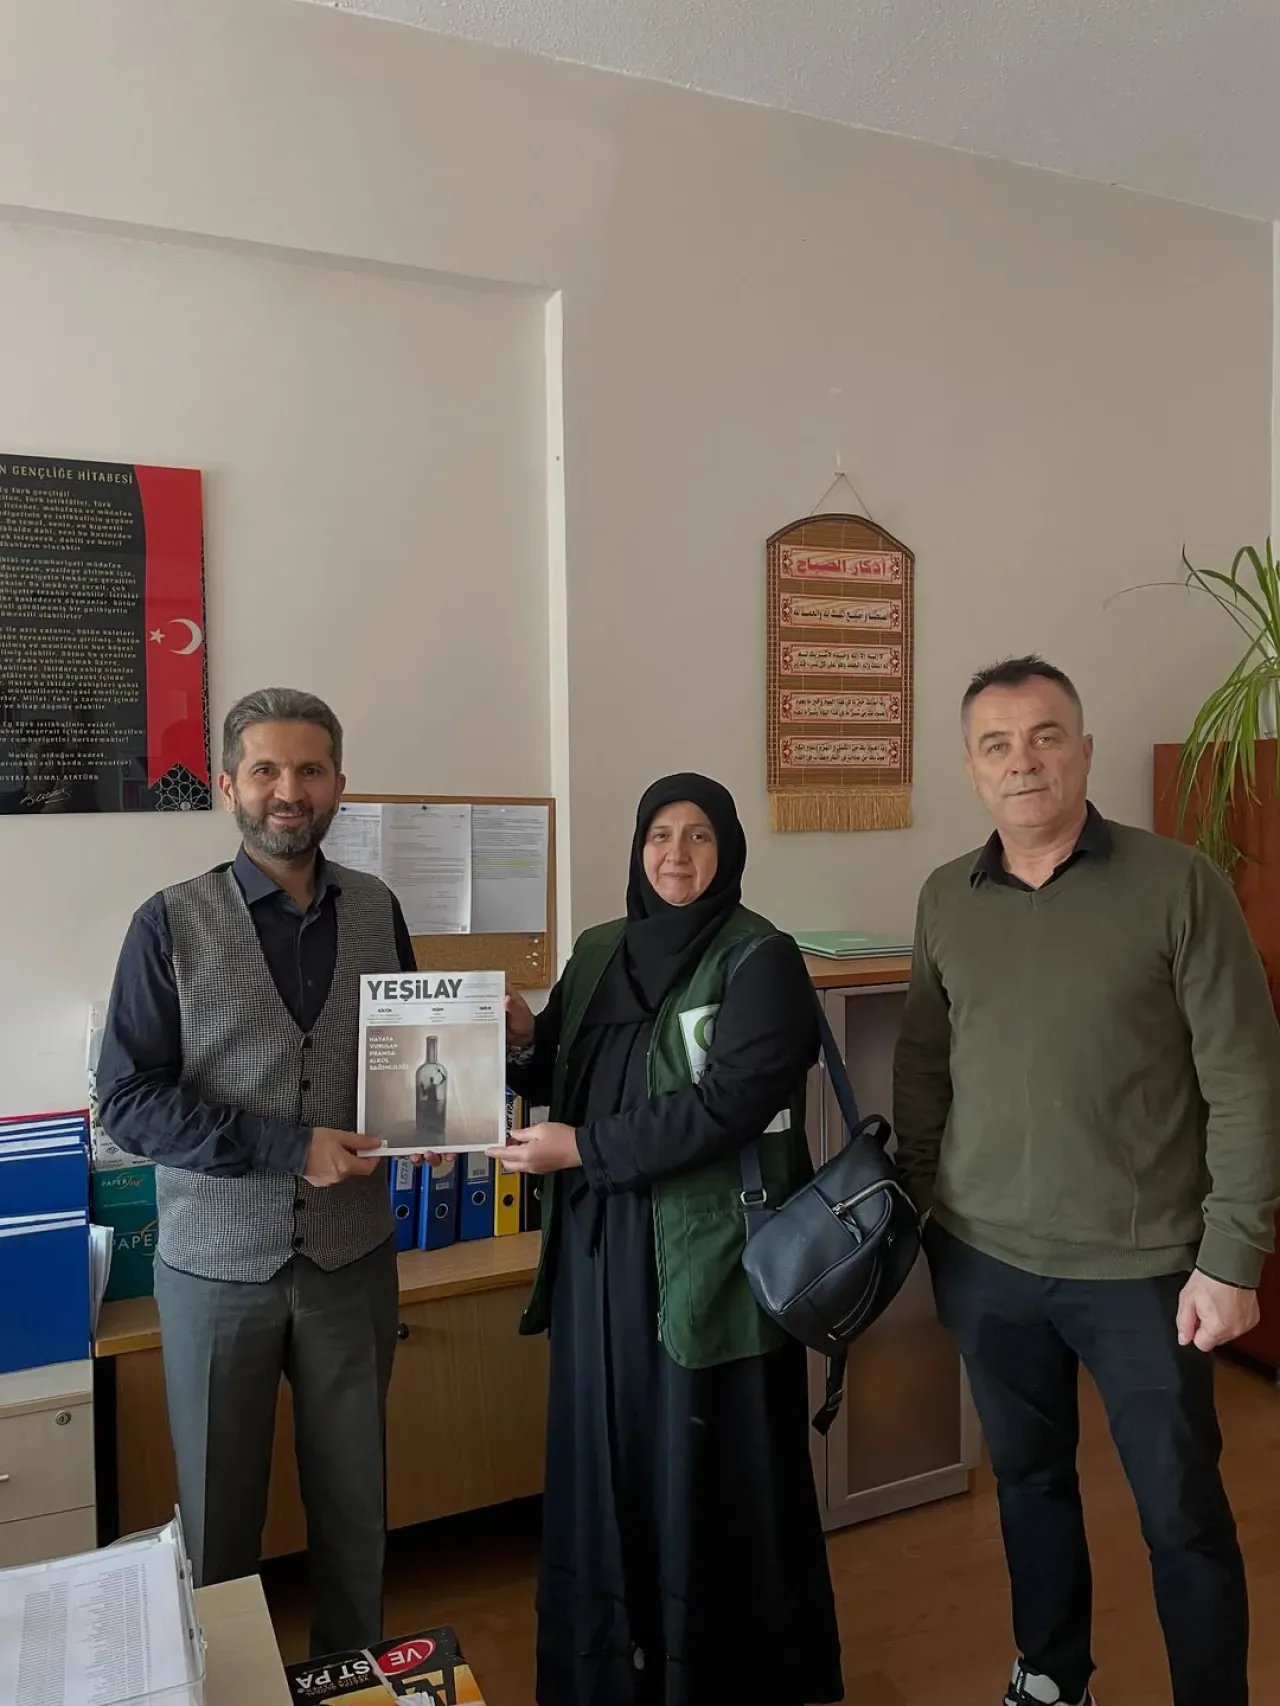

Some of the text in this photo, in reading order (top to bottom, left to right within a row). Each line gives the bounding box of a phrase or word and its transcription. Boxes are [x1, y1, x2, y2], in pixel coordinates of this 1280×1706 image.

[12, 466, 73, 479] GENÇLİĞE
[78, 471, 132, 484] HİTABESİ
[112, 1234, 153, 1250] APE
[388, 1647, 423, 1666] VE
